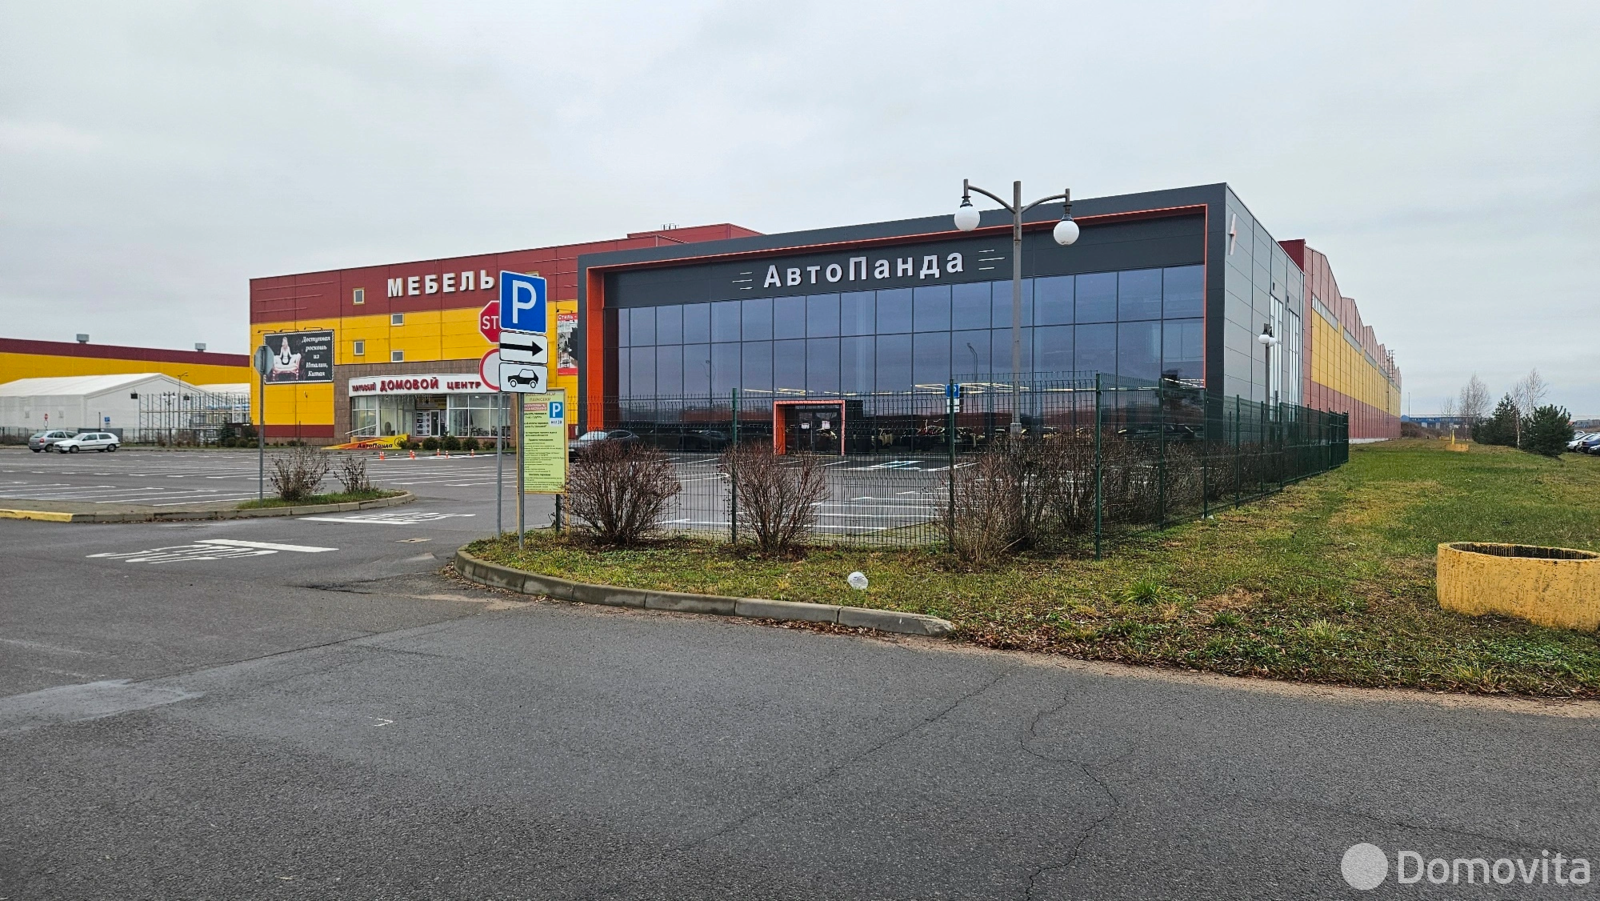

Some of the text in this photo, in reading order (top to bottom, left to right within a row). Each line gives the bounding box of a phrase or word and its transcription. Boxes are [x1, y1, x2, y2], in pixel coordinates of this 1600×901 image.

[763, 252, 964, 288] АвтоПанда
[387, 269, 495, 298] МЕБЕЛЬ
[512, 279, 537, 324] P
[482, 315, 499, 330] ST
[380, 377, 439, 393] ДОМОВОЙ
[446, 381, 482, 390] ЦЕНТР
[552, 403, 561, 417] P
